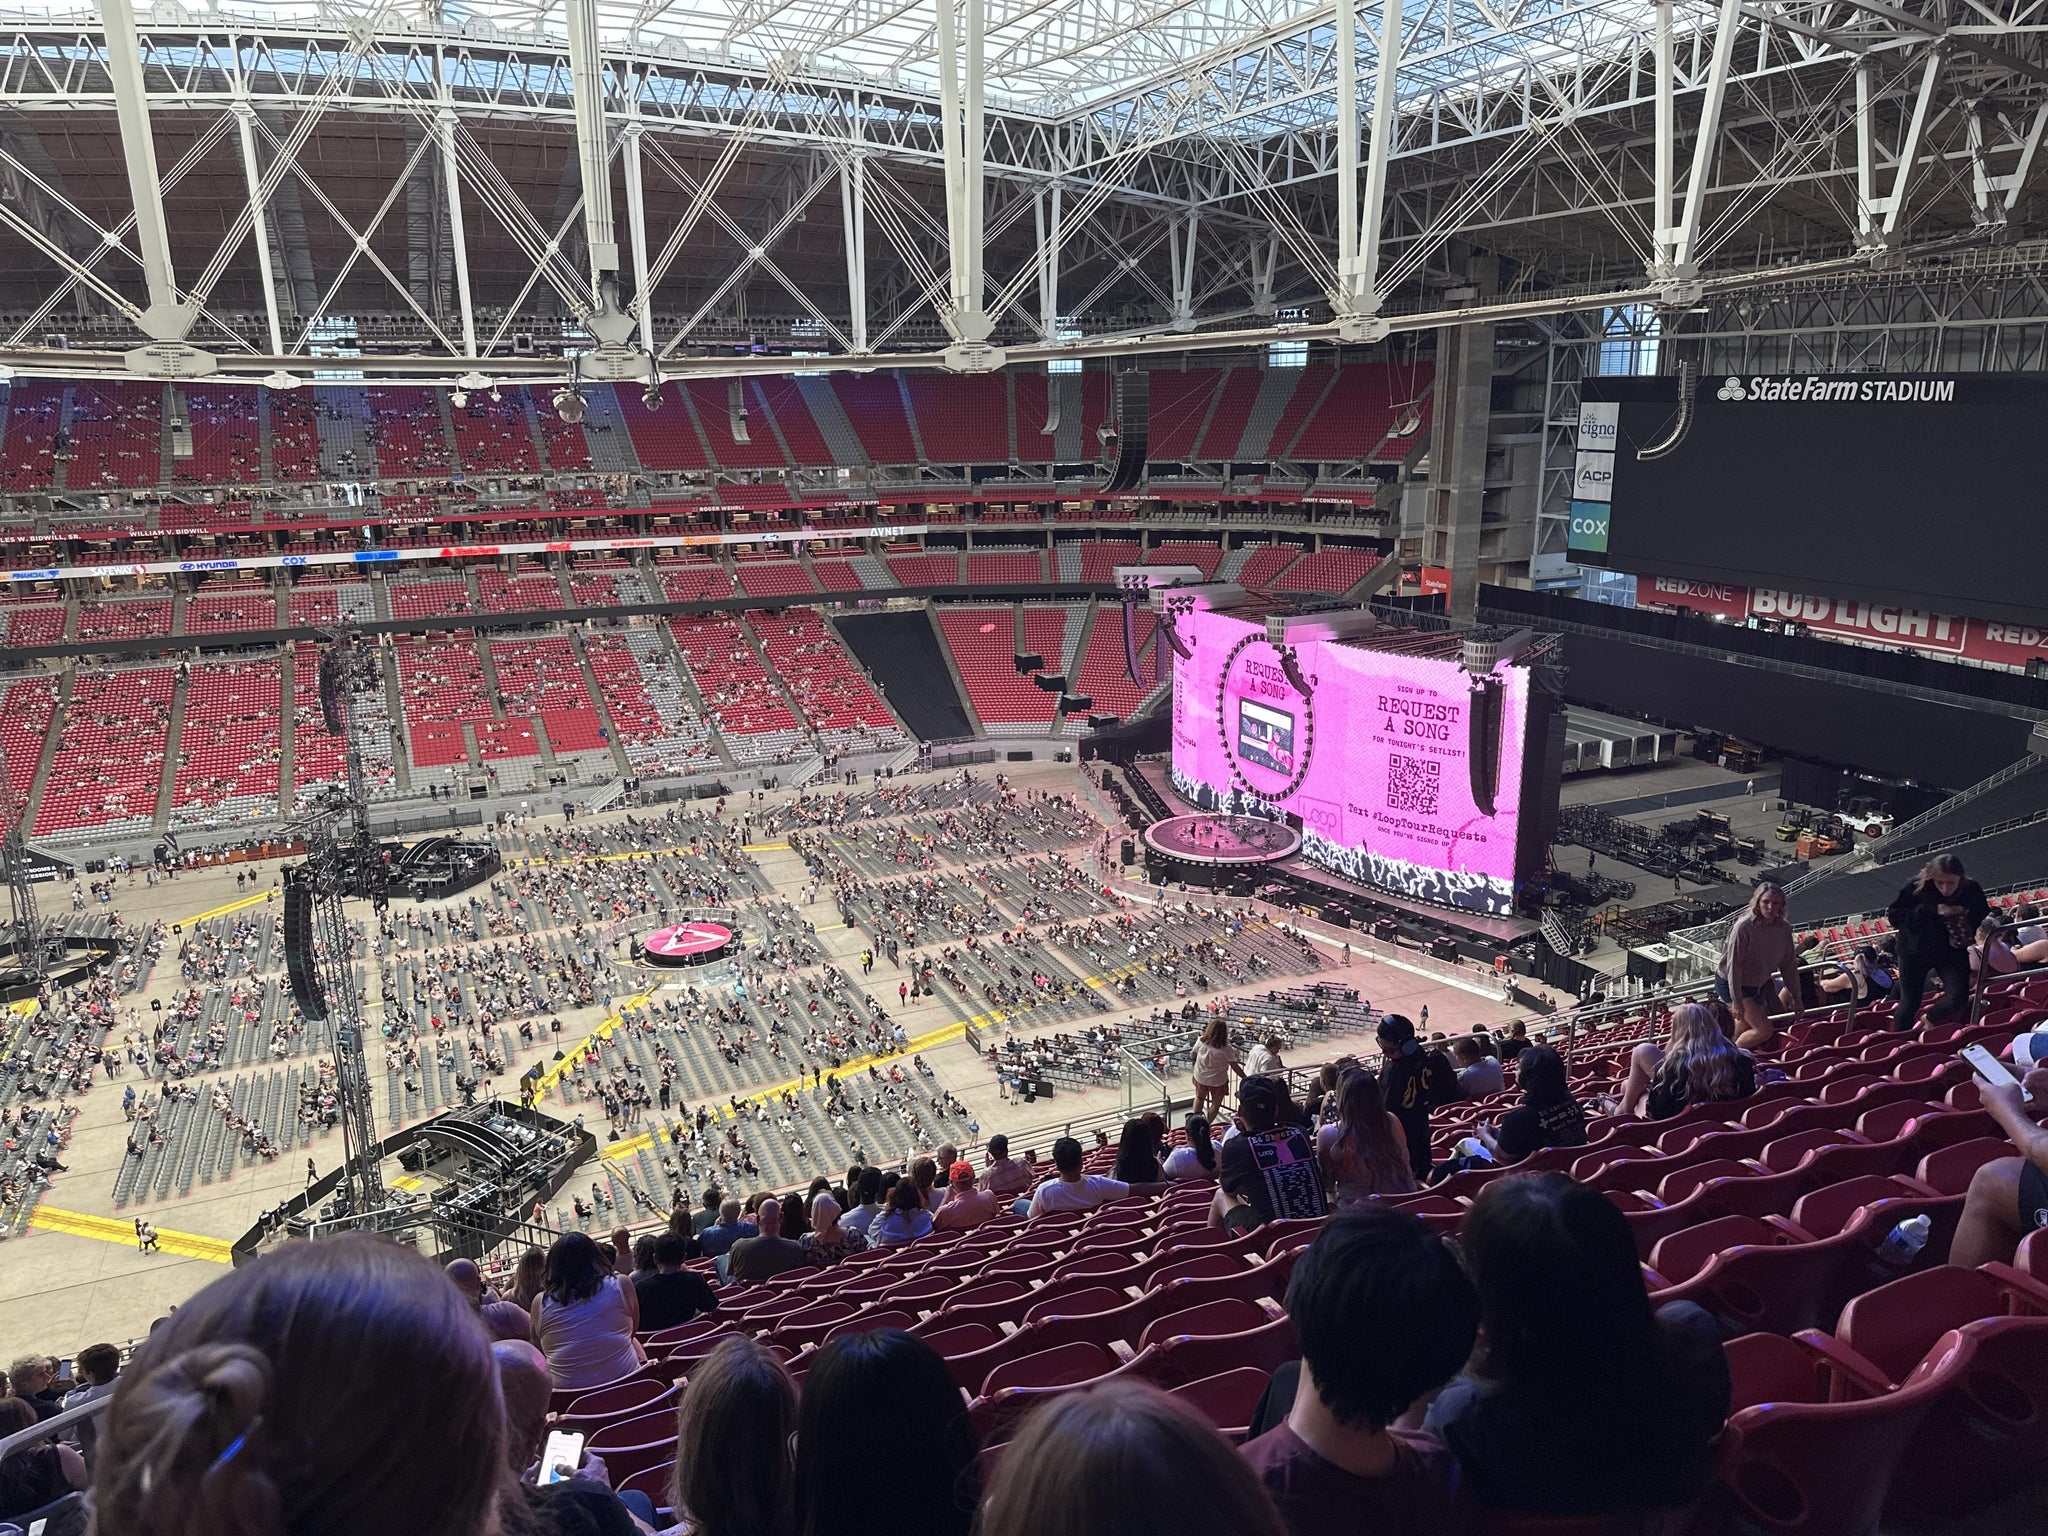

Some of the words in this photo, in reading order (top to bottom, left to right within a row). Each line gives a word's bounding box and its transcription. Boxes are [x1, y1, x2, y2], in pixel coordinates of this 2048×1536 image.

[1860, 380, 1955, 402] STADIUM
[1581, 470, 1612, 482] ACP
[129, 529, 165, 537] WILLIAM
[175, 527, 209, 535] BIDWILL
[870, 526, 905, 537] AVNET
[1572, 517, 1607, 536] COX
[30, 534, 67, 542] BIDWILL,
[90, 565, 134, 576] SAFEWAY
[196, 561, 239, 570] HYUNDAI
[282, 556, 307, 566] COX
[1655, 576, 1734, 602] REDZONE
[1752, 587, 1831, 622] BUD
[1834, 600, 1960, 642] LIGHT
[1245, 659, 1289, 686] REQUES
[1249, 677, 1257, 692] A
[1260, 680, 1286, 701] SONG
[1397, 685, 1413, 694] SIGN
[1377, 695, 1460, 724] REQUEST
[1384, 715, 1396, 733] A
[1403, 719, 1450, 742] SONG
[1372, 735, 1385, 744] FOR
[1388, 738, 1425, 752] TONIGHT'S
[1428, 746, 1466, 758] SETLIST!
[1347, 803, 1369, 818] Text
[1372, 811, 1488, 843] #LoopTourRequests
[1377, 825, 1391, 835] ONCE
[1416, 835, 1439, 845] SIGNED
